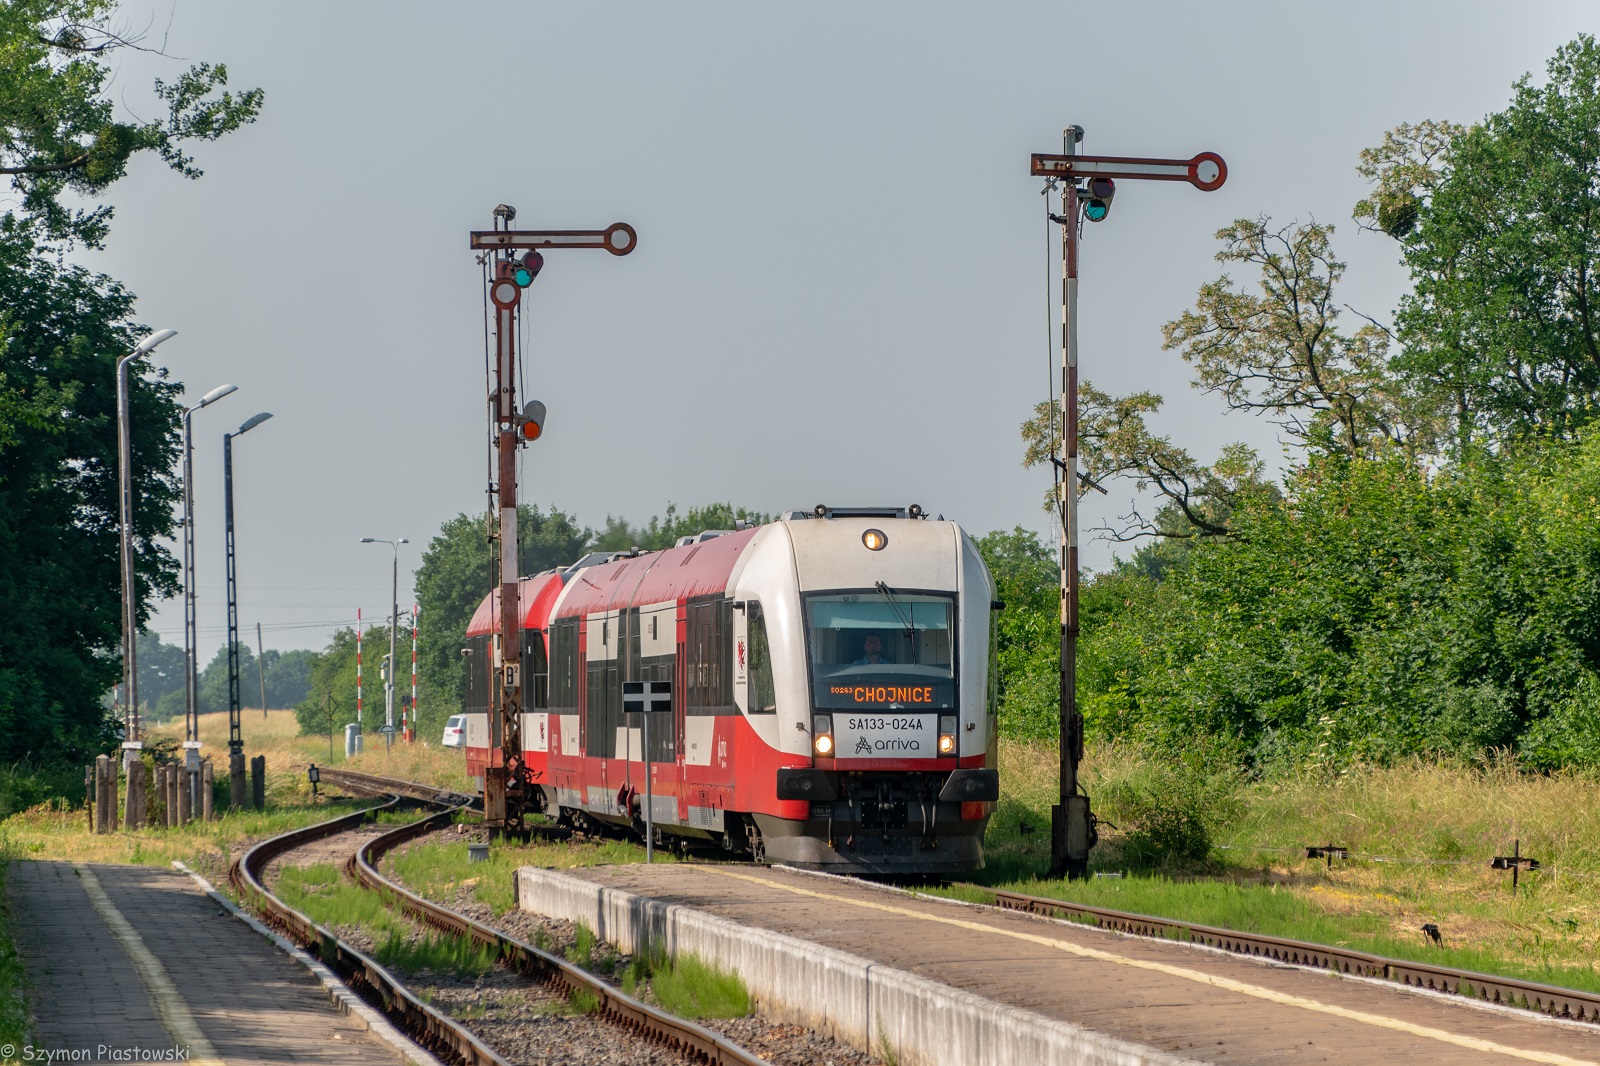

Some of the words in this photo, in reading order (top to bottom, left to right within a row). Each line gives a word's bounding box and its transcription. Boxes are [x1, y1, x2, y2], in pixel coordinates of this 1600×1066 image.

[854, 687, 933, 703] CHOJNICE
[849, 718, 923, 730] SA133-024A
[874, 737, 920, 751] arriva
